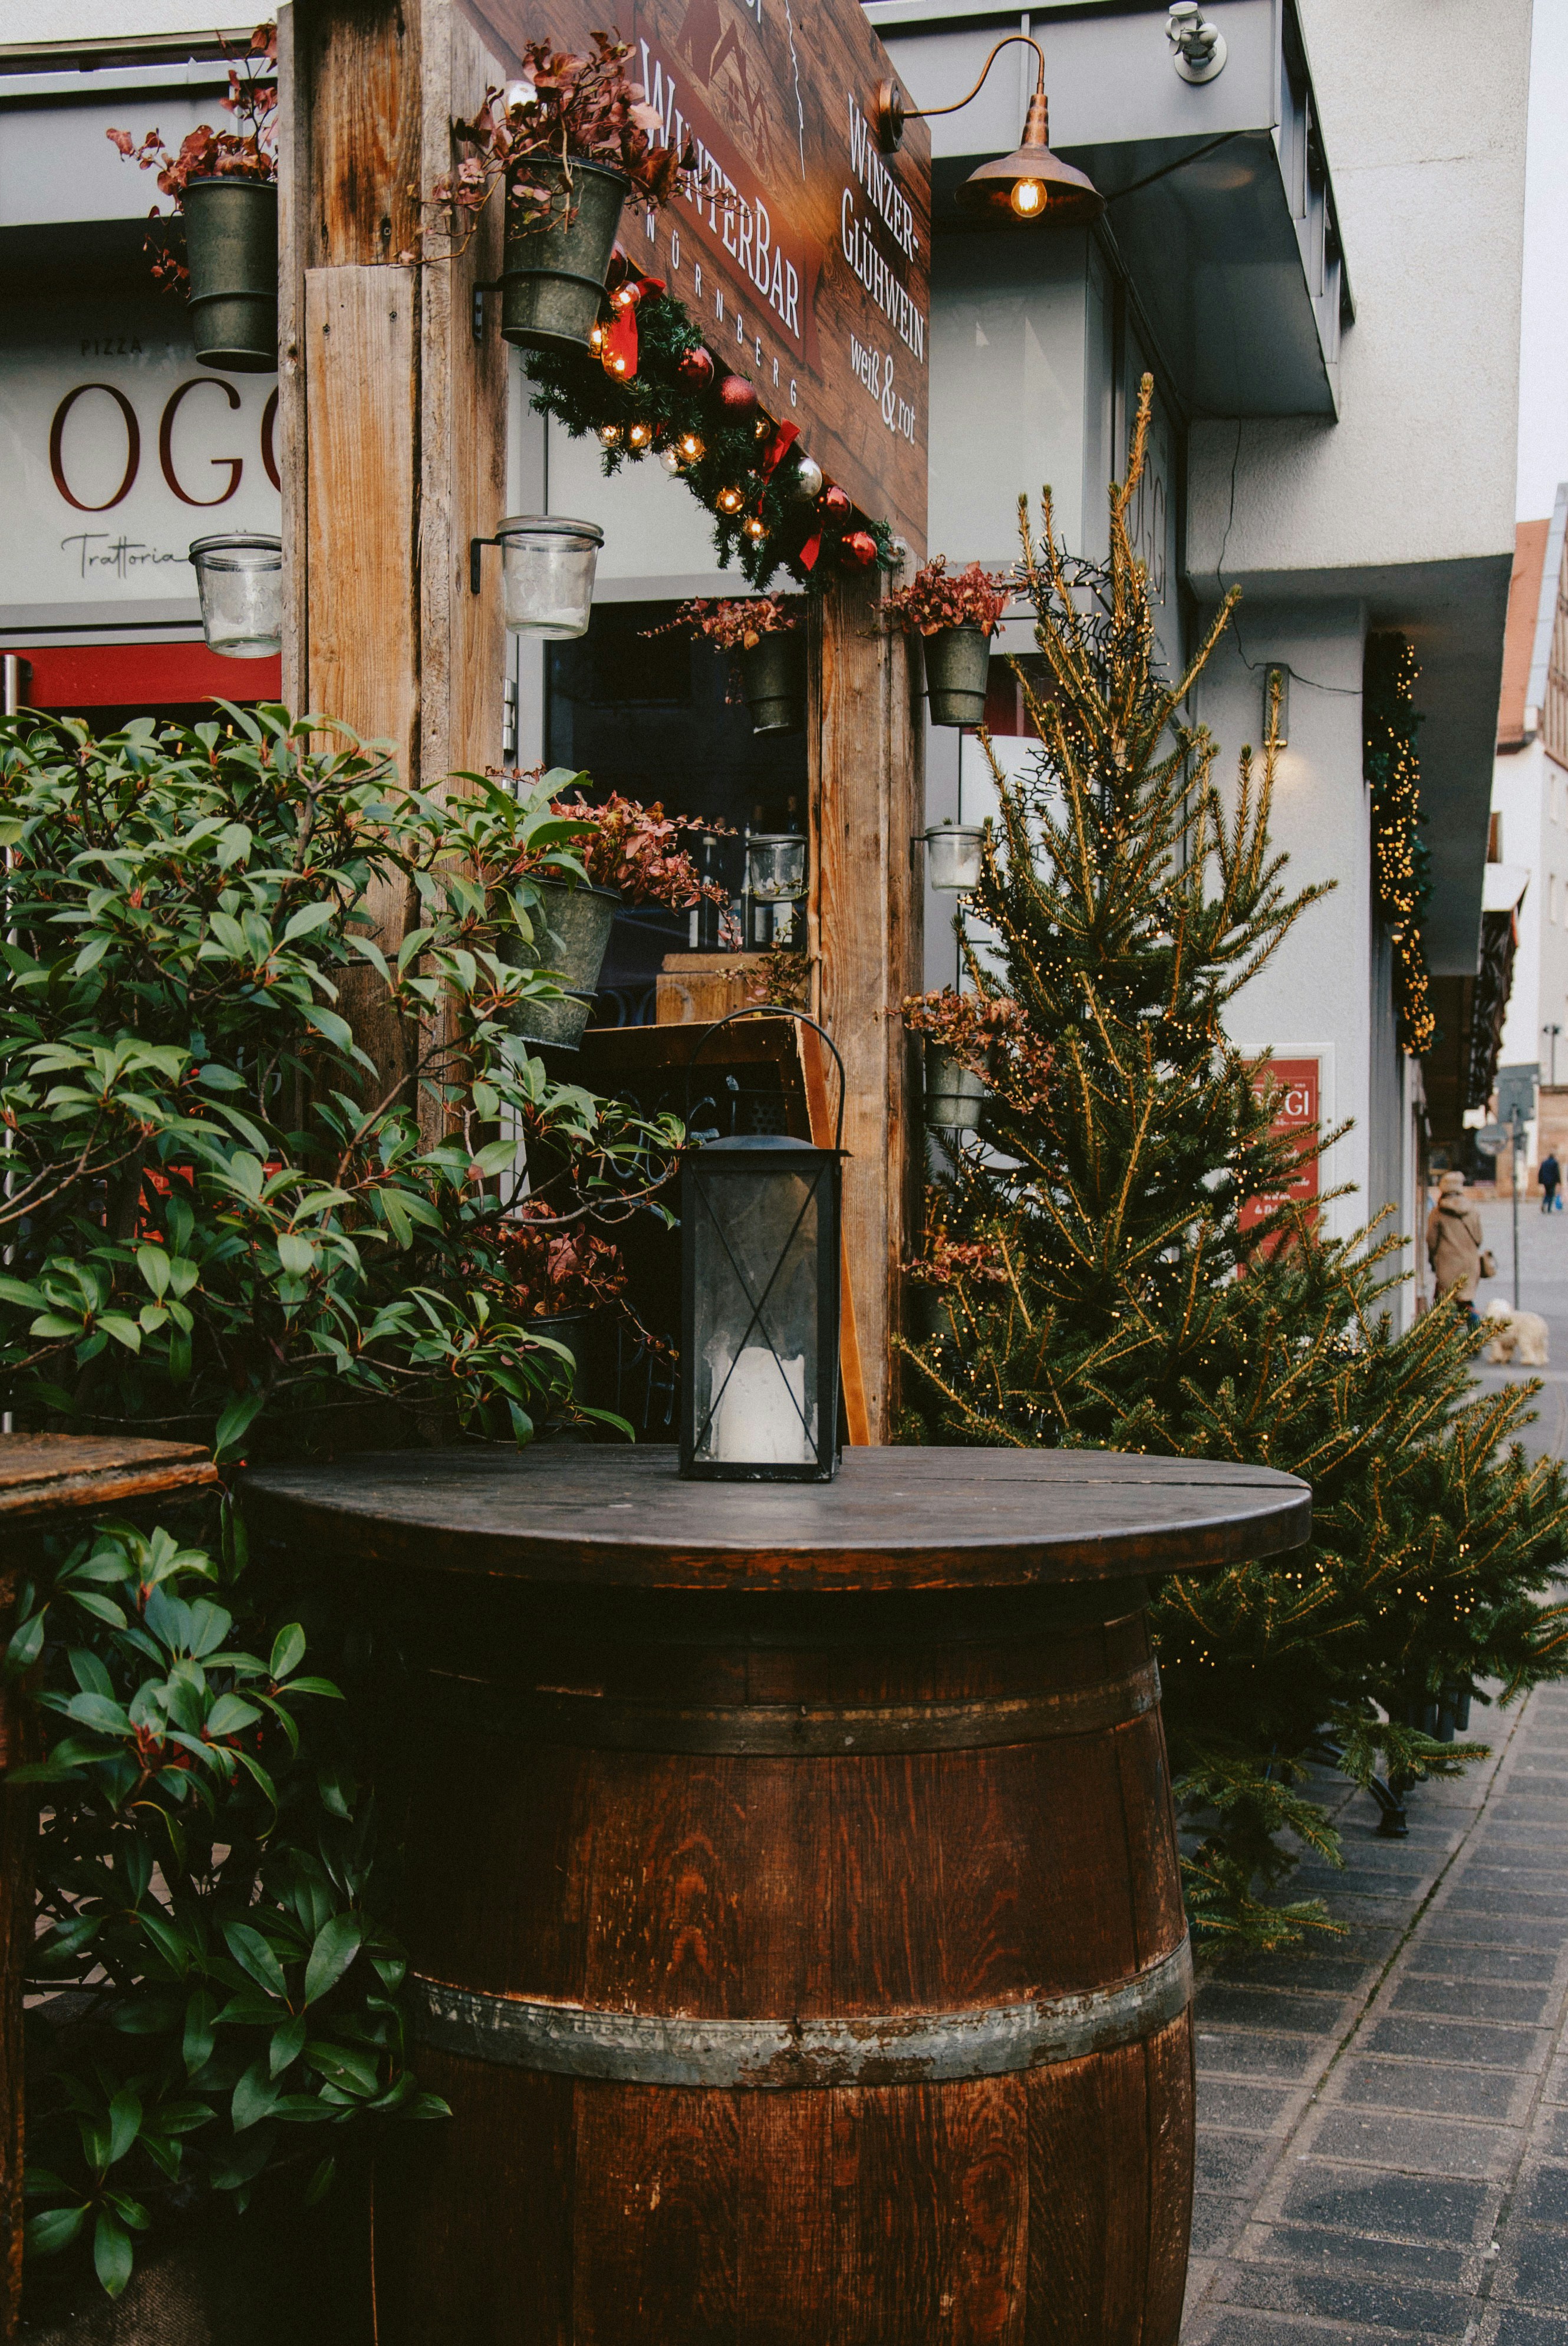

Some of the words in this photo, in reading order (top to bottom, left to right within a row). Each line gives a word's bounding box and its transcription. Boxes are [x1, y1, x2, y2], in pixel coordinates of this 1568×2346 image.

[848, 92, 919, 261] WINZER-
[842, 187, 924, 364] GLÜHWEIN
[81, 335, 143, 356] PIZZA
[851, 334, 879, 400] weiß
[882, 355, 896, 432] &
[898, 398, 915, 445] rot
[50, 377, 281, 512] OG
[61, 533, 190, 578] Trattoria
